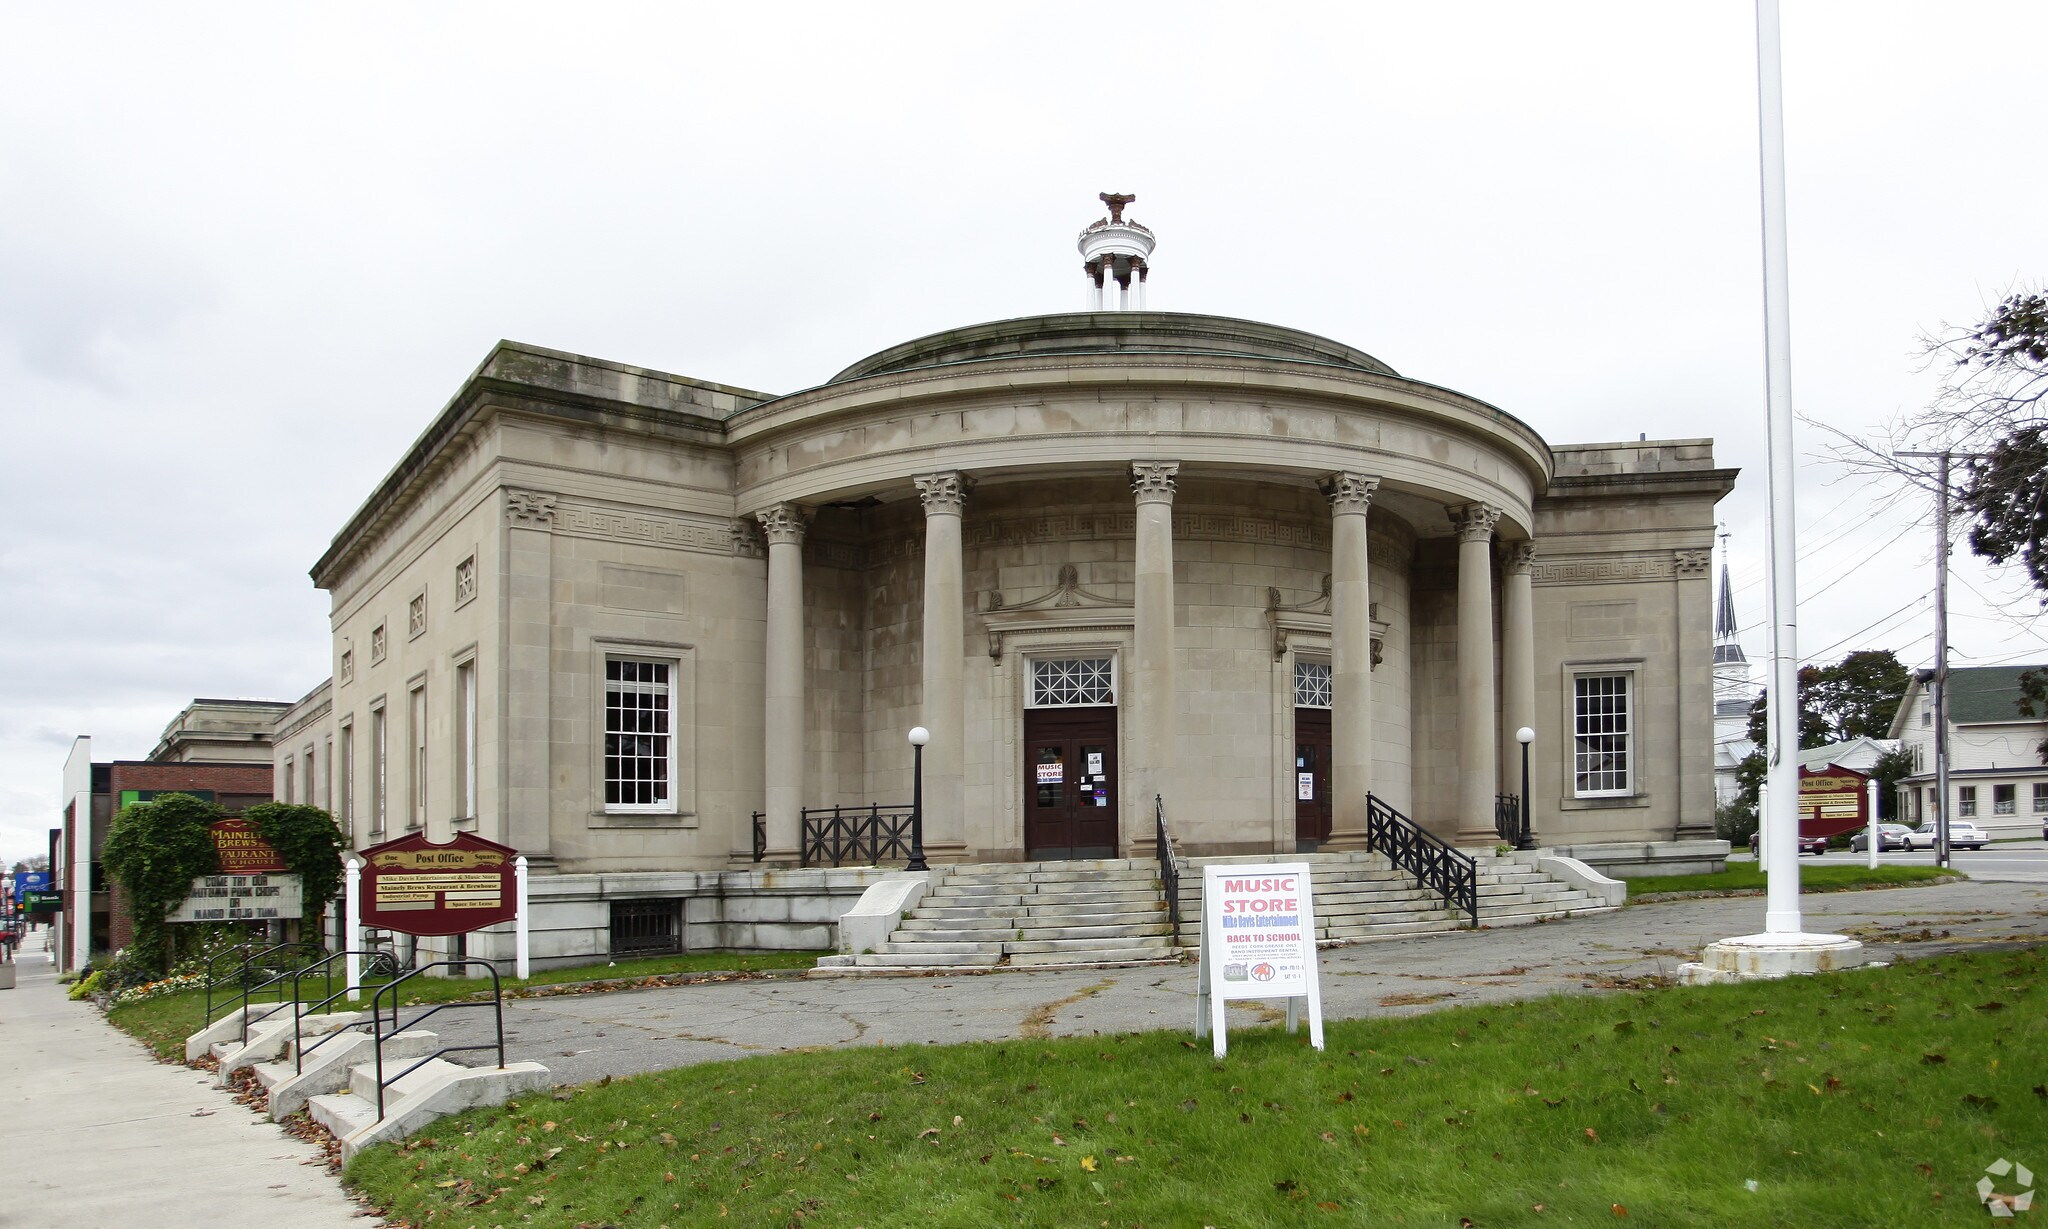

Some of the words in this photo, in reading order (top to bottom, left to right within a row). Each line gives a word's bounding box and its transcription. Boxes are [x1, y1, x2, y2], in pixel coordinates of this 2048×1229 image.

[218, 840, 258, 848] BREWS
[416, 853, 434, 863] Post
[438, 853, 464, 863] Office
[206, 877, 228, 887] COME
[232, 877, 247, 886] TRY
[252, 876, 268, 886] OUR
[1225, 879, 1295, 893] MUSIC
[230, 887, 253, 897] PORK
[255, 886, 280, 896] CHOPS
[230, 898, 240, 908] OR
[1224, 899, 1297, 913] STORE
[194, 909, 224, 919] MANGO
[1222, 915, 1238, 928] Mike
[1238, 914, 1255, 928] Davis
[1256, 914, 1299, 927] Entertainment
[1227, 934, 1251, 943] BACK
[1253, 934, 1265, 942] TO
[1266, 933, 1302, 942] SCHOOL
